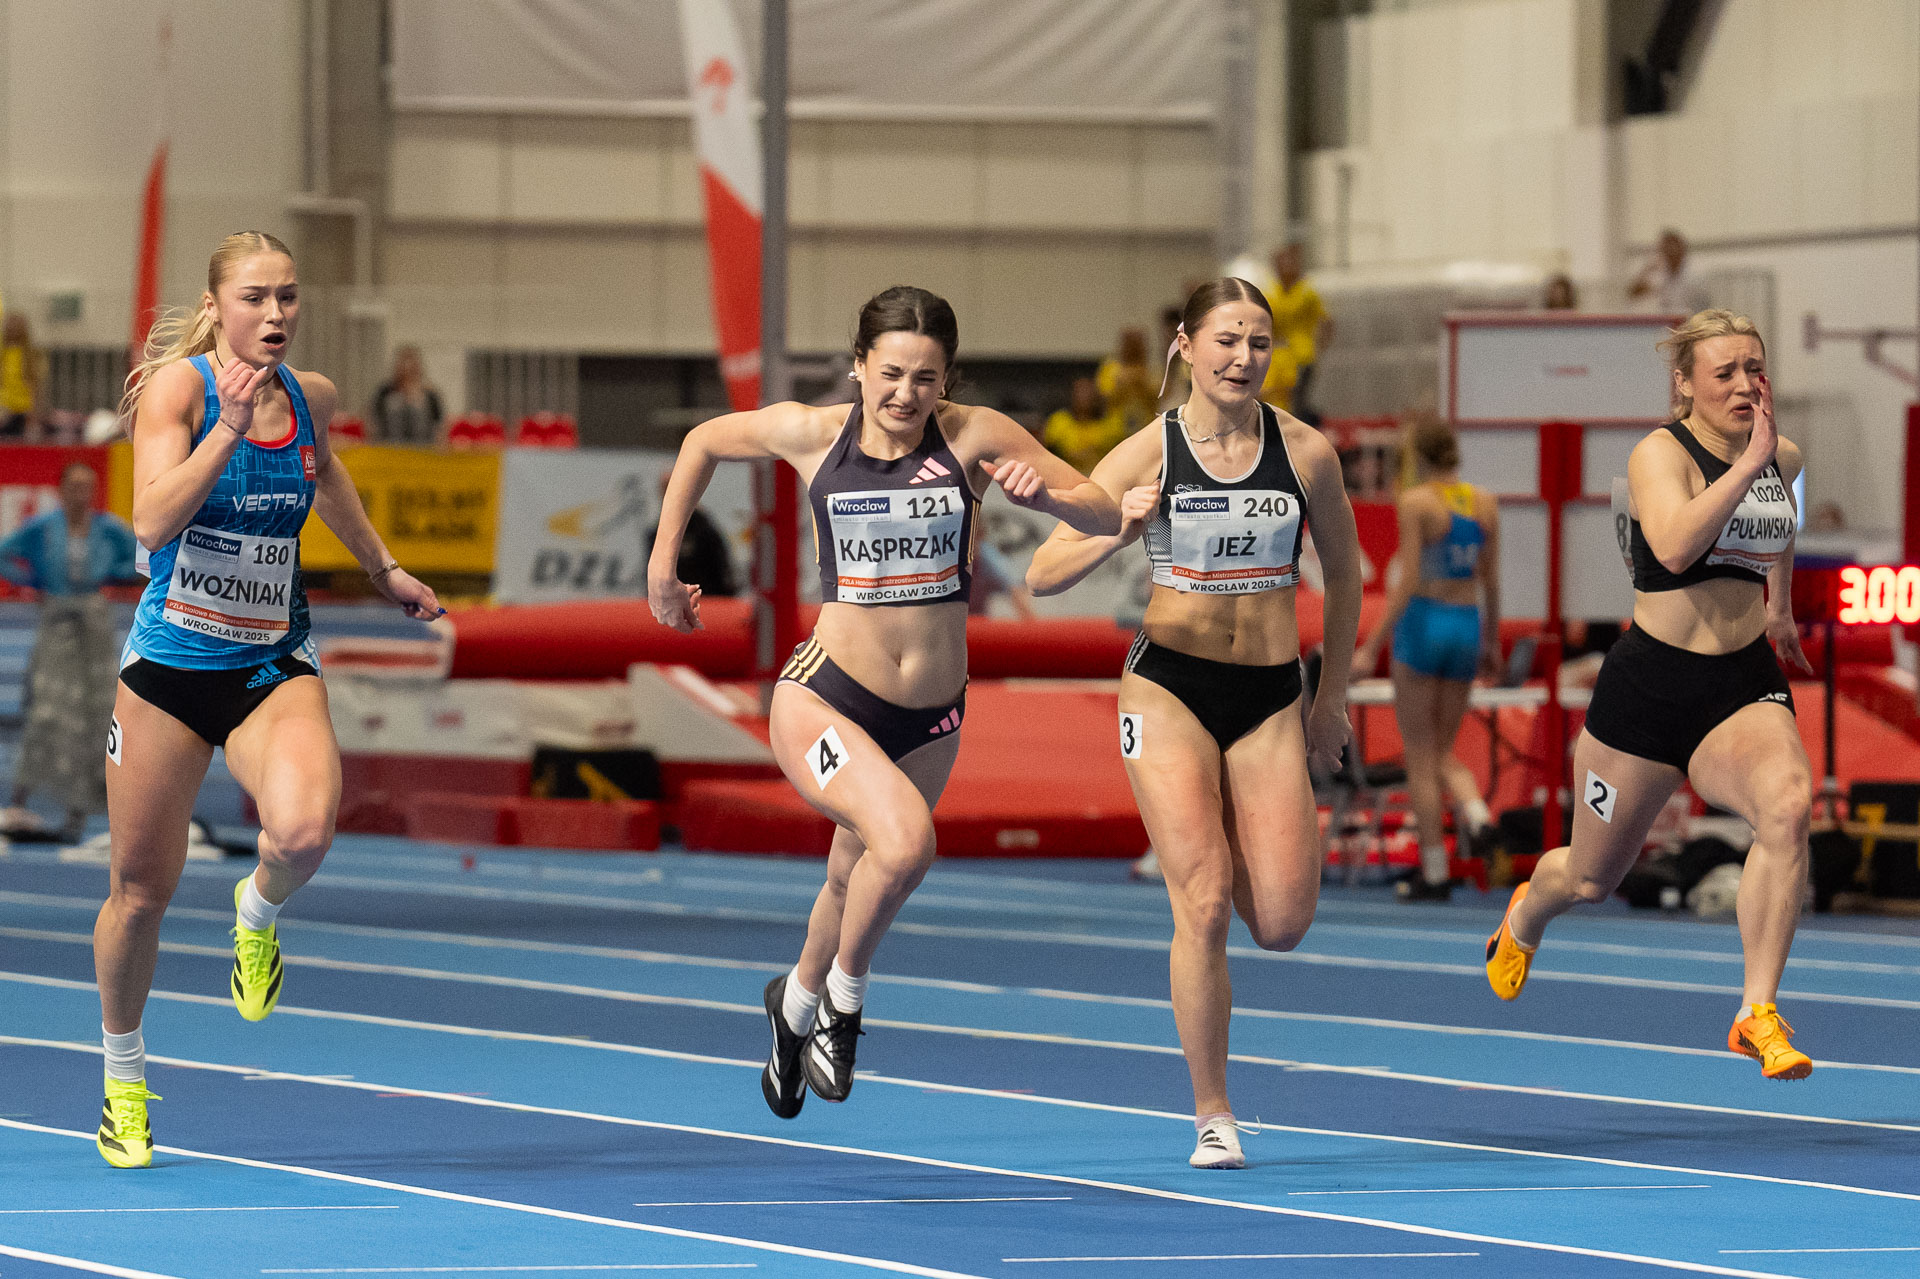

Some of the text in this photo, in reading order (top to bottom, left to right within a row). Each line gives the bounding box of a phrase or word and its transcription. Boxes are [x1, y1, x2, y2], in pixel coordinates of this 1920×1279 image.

[232, 493, 307, 512] VECTRA
[1178, 498, 1227, 510] Wrocław
[1750, 485, 1785, 502] 1028
[835, 499, 888, 513] Wrocław
[907, 495, 954, 519] 121
[1243, 497, 1289, 518] 240
[1726, 517, 1794, 540] PUŁAWSKA
[190, 532, 239, 552] Wrocław
[839, 530, 957, 563] KASPRZAK
[1213, 530, 1257, 558] JEŻ
[253, 543, 289, 565] 180
[918, 574, 938, 582] Polski
[1212, 570, 1248, 579] Mistrzostwa
[1248, 568, 1266, 576] Polski
[180, 567, 287, 607] WOŹNIAK
[856, 583, 948, 601] WROCŁAW 2025
[1190, 580, 1276, 592] WROCŁAW 2025
[182, 617, 270, 641] WROCŁAW 2025
[246, 672, 288, 689] adidas
[1123, 716, 1135, 755] 3
[819, 737, 840, 775] 4
[1590, 780, 1608, 816] 2
